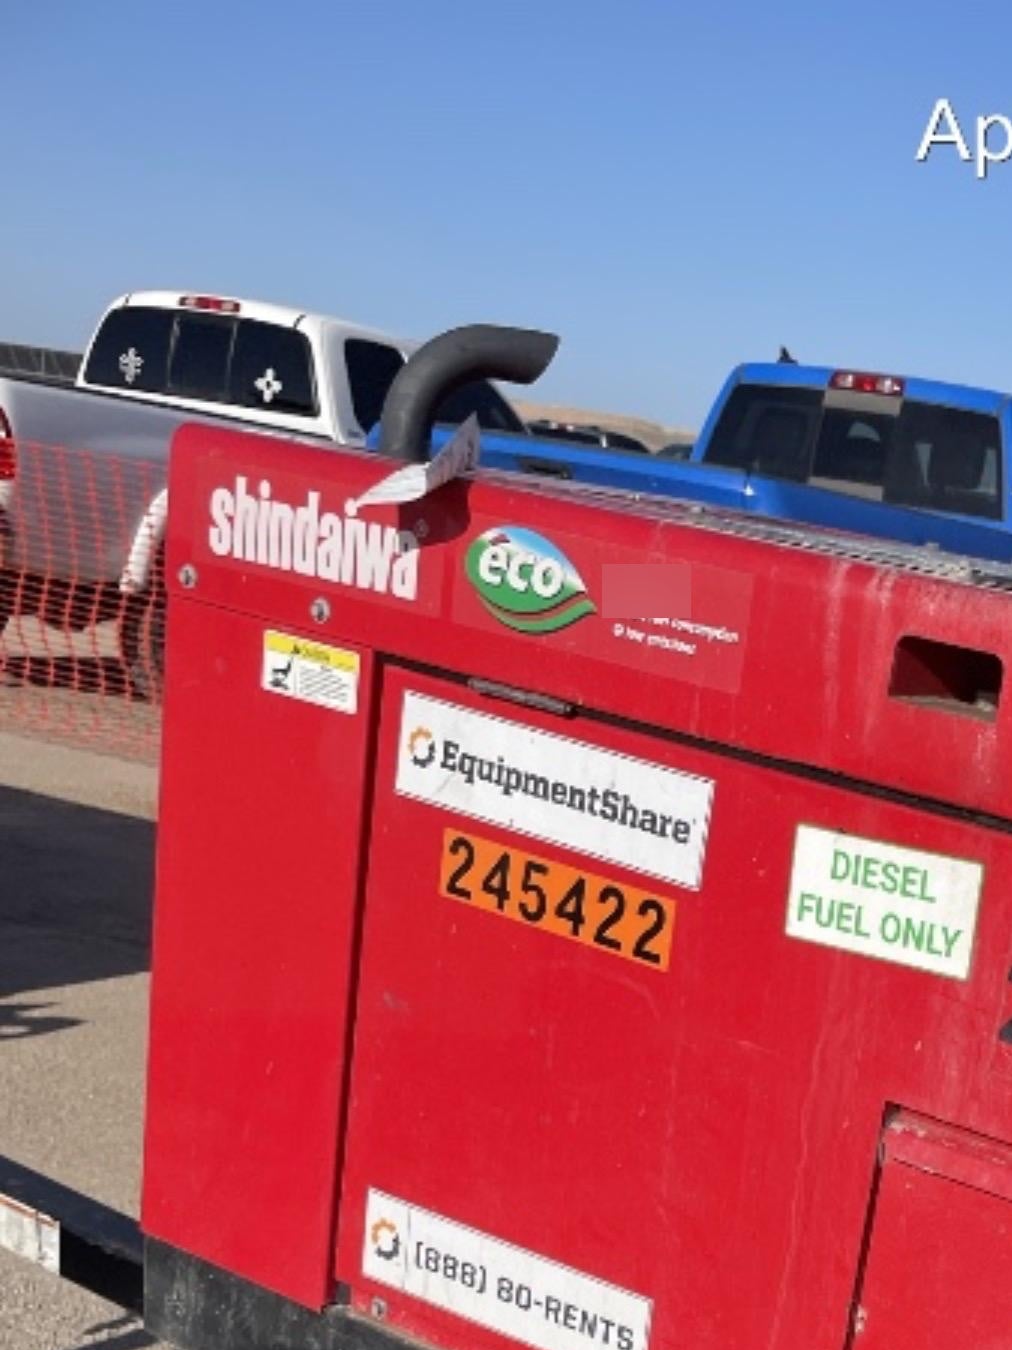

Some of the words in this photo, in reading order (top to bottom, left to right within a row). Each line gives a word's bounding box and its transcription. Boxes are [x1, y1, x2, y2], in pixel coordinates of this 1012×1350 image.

[208, 475, 420, 601] shindaiwa
[440, 740, 691, 844] EquipmentShare
[446, 837, 667, 964] 245422
[830, 849, 937, 904] DIESEL
[797, 892, 871, 939] FUEL
[880, 912, 964, 958] ONLY
[415, 1241, 487, 1294] (888)
